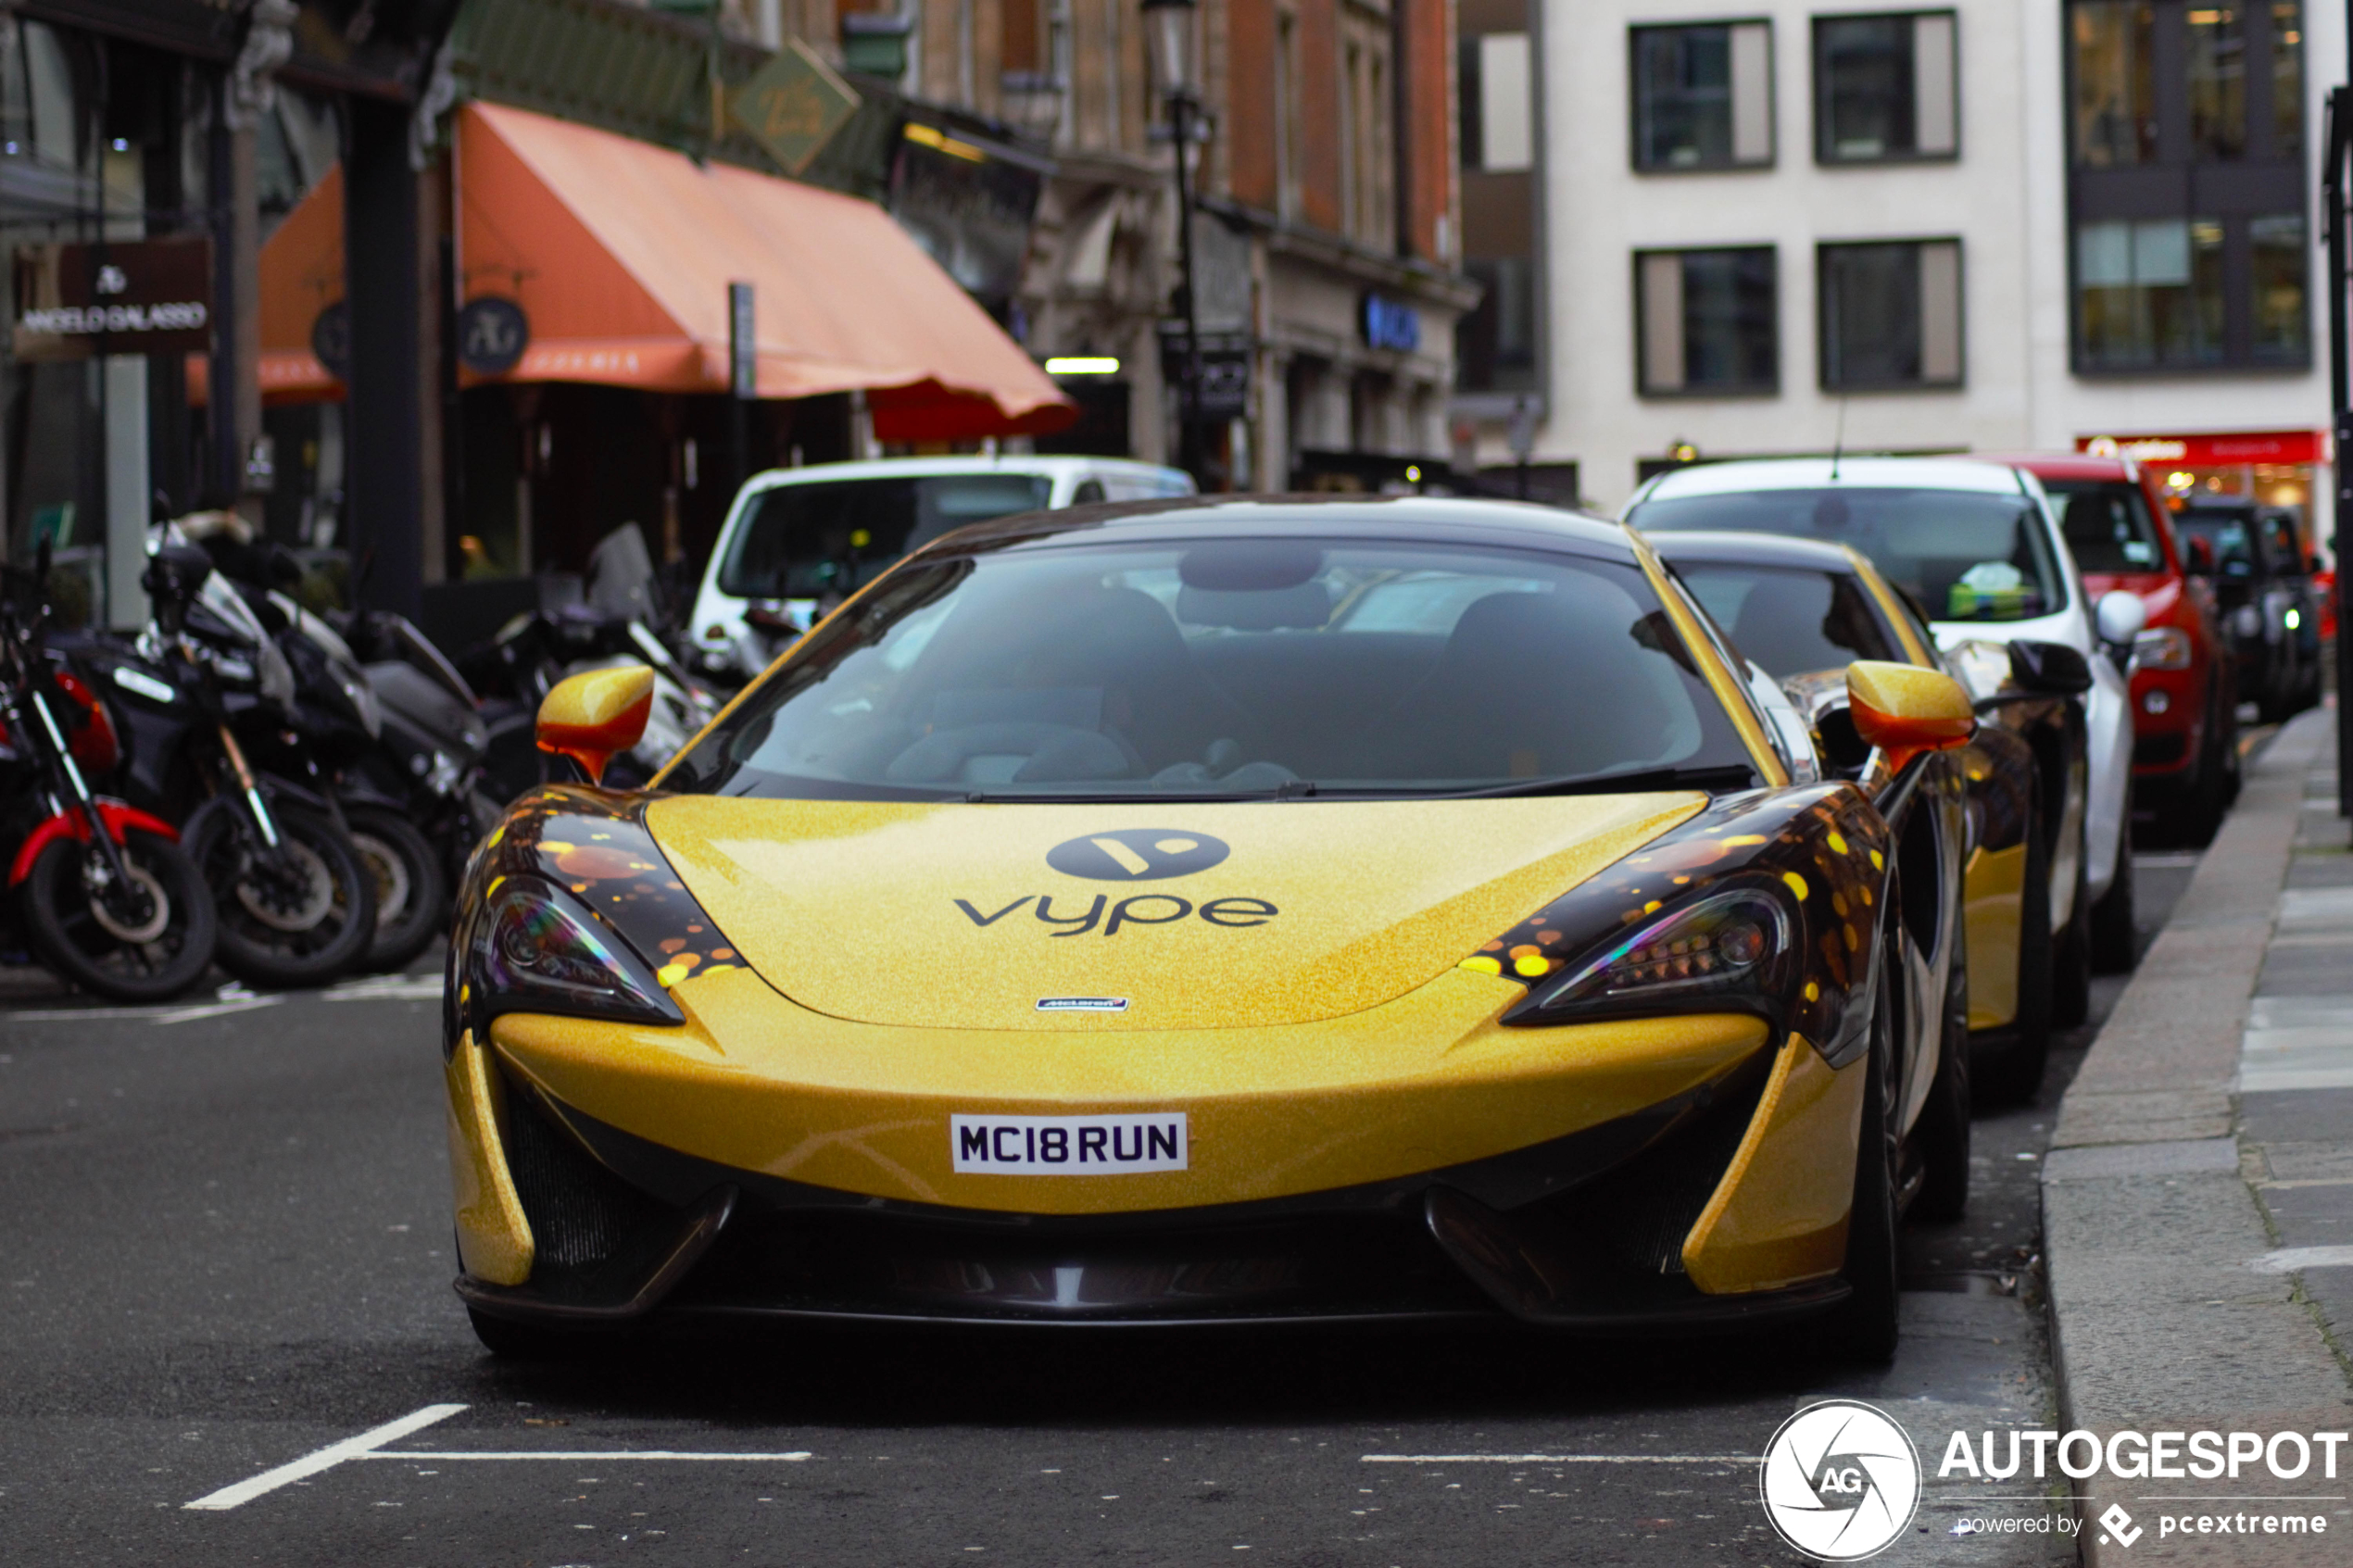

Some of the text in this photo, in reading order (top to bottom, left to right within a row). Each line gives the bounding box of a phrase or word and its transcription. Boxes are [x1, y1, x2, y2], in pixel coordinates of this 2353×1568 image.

[23, 302, 208, 333] ANGELO GALASSO
[953, 894, 1279, 937] vype
[960, 1124, 1178, 1163] MC18 RUN
